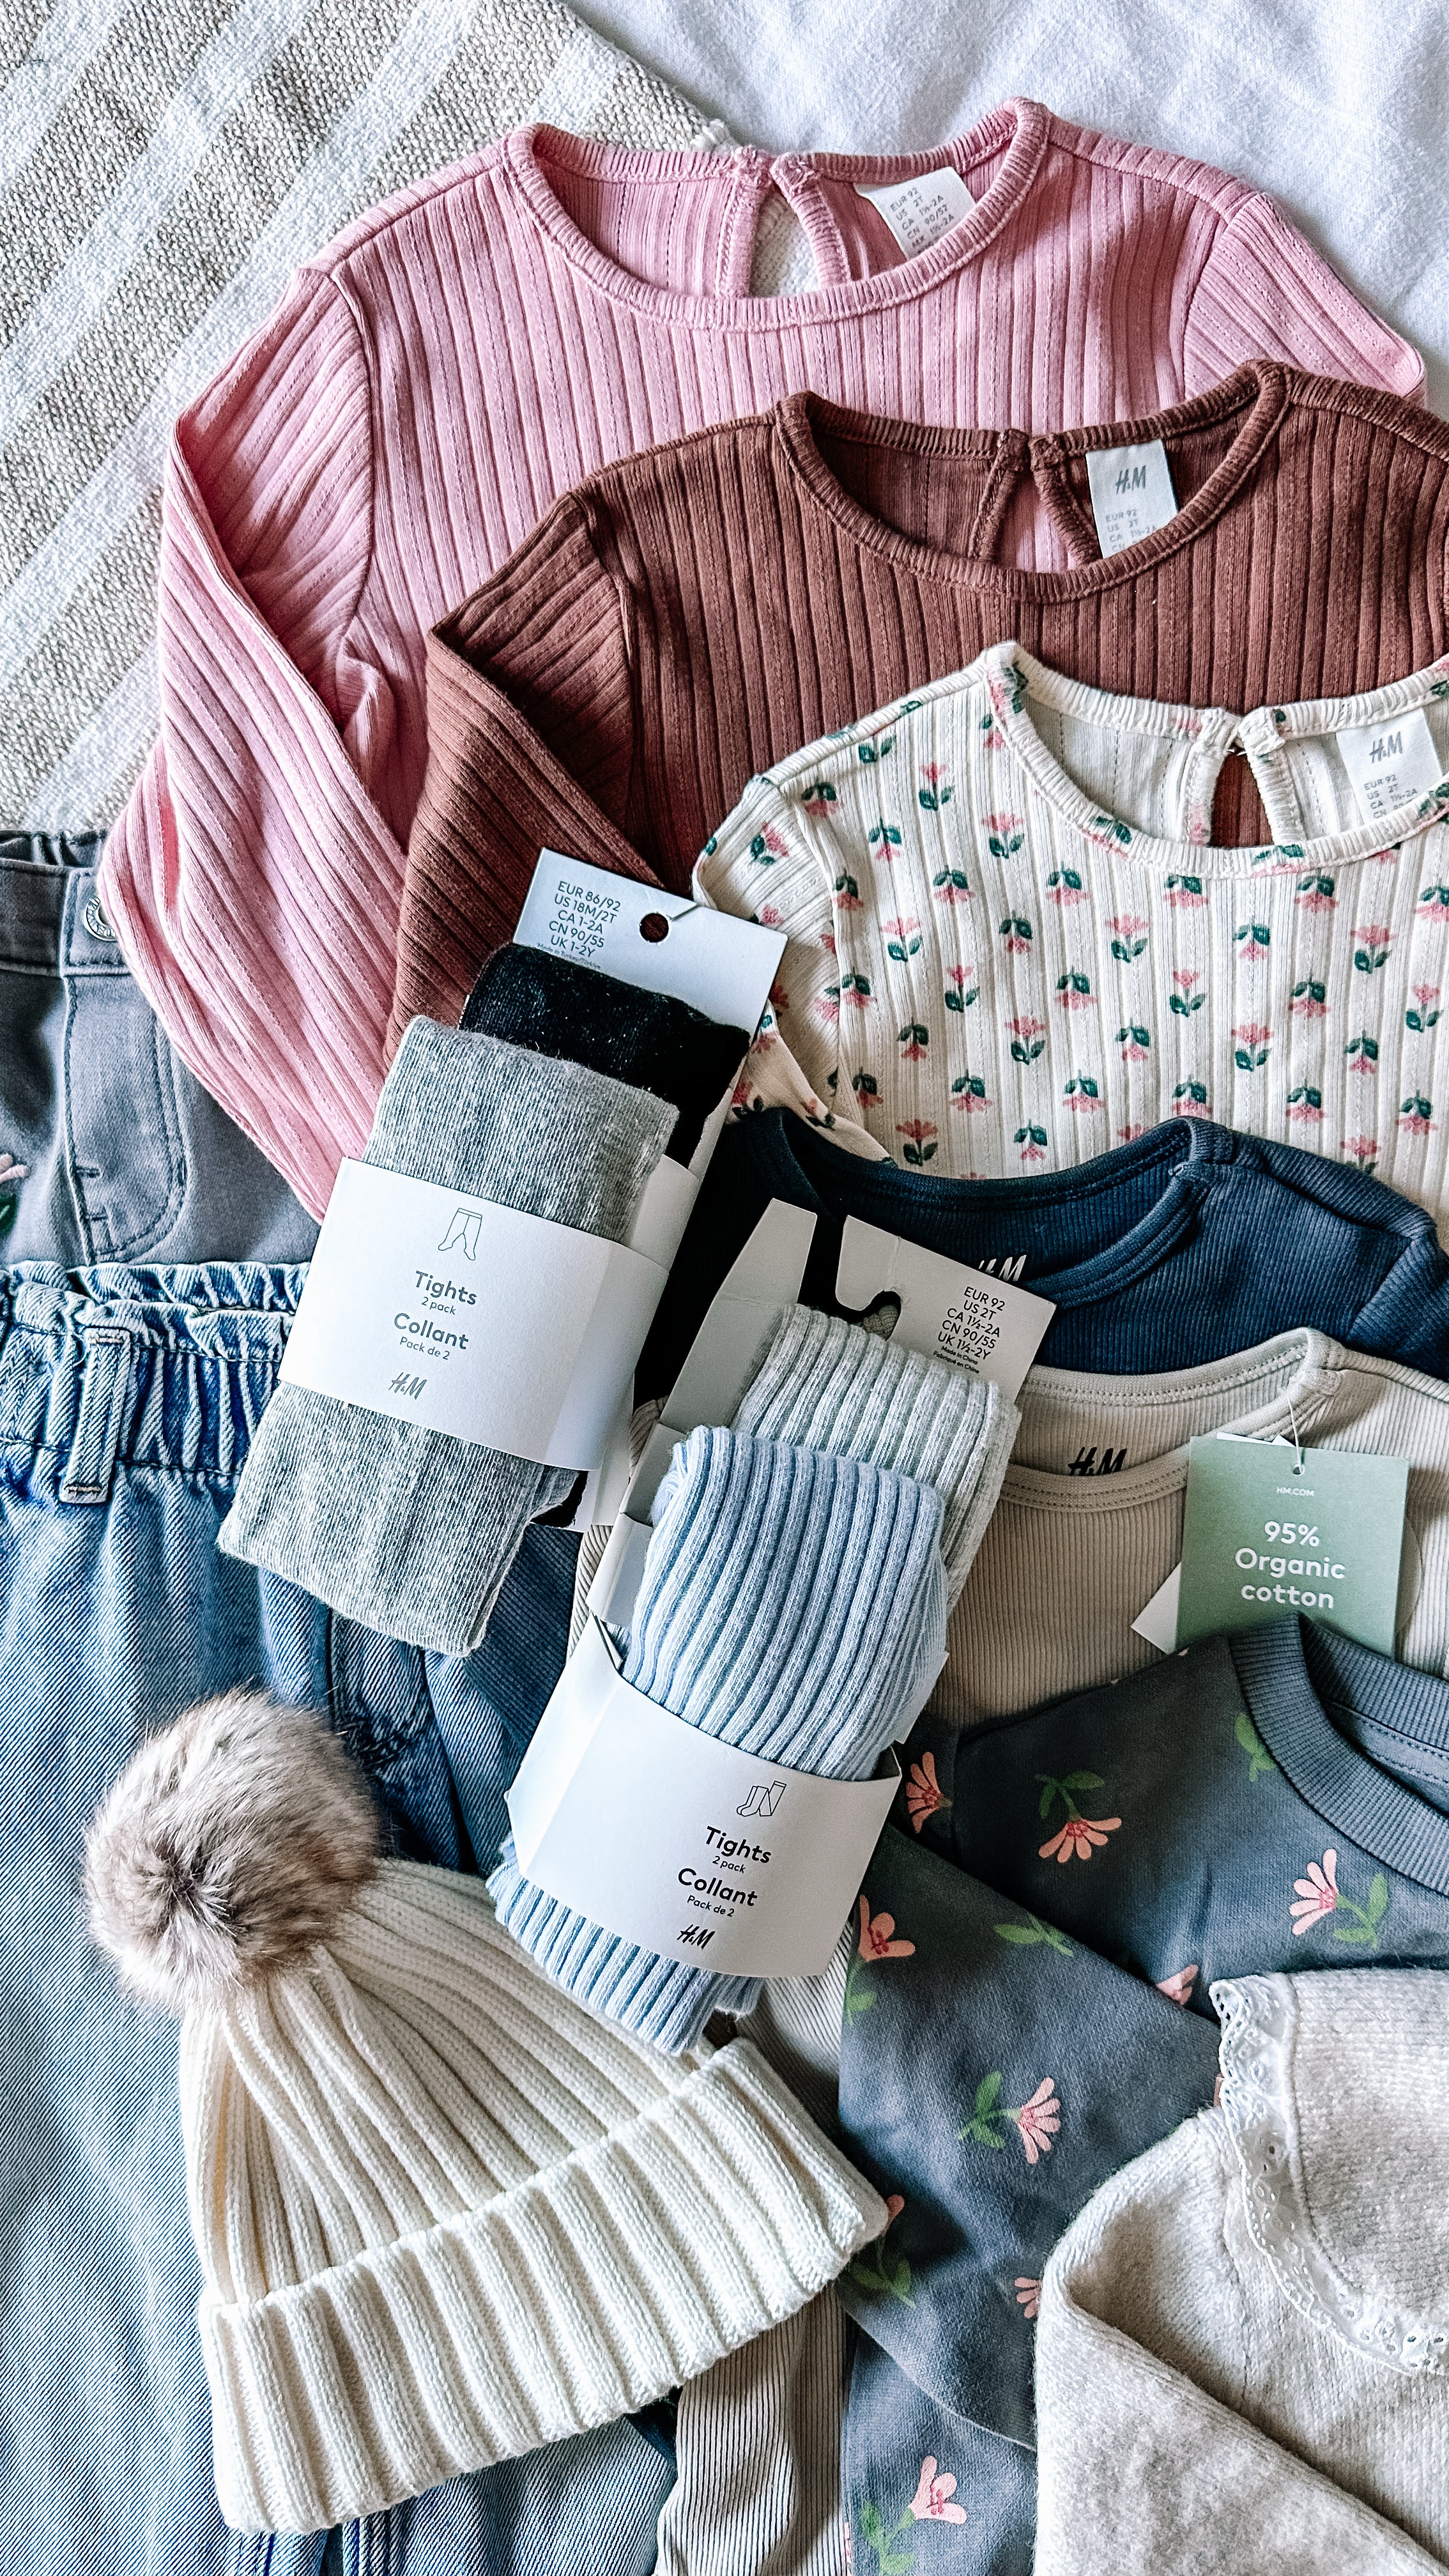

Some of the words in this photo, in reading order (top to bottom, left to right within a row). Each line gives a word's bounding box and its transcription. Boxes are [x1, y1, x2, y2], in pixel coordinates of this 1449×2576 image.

[890, 196, 907, 212] EUR
[908, 187, 918, 198] 92
[896, 209, 908, 220] US
[914, 196, 923, 208] 2T
[902, 218, 914, 230] CA
[907, 227, 920, 239] CN
[1115, 465, 1146, 495] H&M
[1106, 512, 1124, 523] EUR
[1108, 524, 1119, 532] US
[1110, 534, 1123, 542] CA
[1370, 732, 1402, 763] H&M
[1364, 779, 1383, 790] EUR
[1367, 791, 1379, 800] US
[1388, 784, 1398, 793] 2T
[1370, 801, 1383, 809] CA
[1374, 809, 1386, 818] CN
[555, 894, 571, 907] US
[574, 900, 617, 923] 18M/2T
[558, 881, 583, 898] EUR
[586, 891, 621, 912] 86/92
[549, 921, 568, 935] CN
[571, 928, 605, 947] 90/55
[558, 910, 575, 924] CA
[579, 917, 602, 934] 1-2A
[551, 935, 569, 949] UK
[571, 942, 595, 957] 1-2Y
[416, 1270, 477, 1305] Tights
[964, 1287, 989, 1305] EUR
[991, 1298, 1005, 1312] 92
[421, 1297, 429, 1307] 2
[430, 1300, 456, 1315] pack
[963, 1300, 980, 1314] US
[981, 1308, 997, 1321] 2T
[394, 1313, 469, 1350] Collant
[942, 1320, 961, 1334] CN
[963, 1328, 996, 1349] 90/55
[947, 1308, 963, 1322] CA
[967, 1315, 1000, 1338] 1½-2A
[400, 1336, 425, 1353] Pack
[427, 1346, 441, 1358] de
[443, 1351, 450, 1360] 2
[938, 1331, 956, 1346] UK
[957, 1339, 992, 1360] 1½-2Y
[941, 1346, 956, 1356] Made
[963, 1355, 978, 1365] China
[965, 1364, 979, 1374] Chine
[388, 1372, 427, 1400] H&M
[1068, 1446, 1128, 1476] H&M
[1276, 1487, 1314, 1497] HM.COM
[1264, 1521, 1321, 1547] 95%
[1235, 1547, 1347, 1579] Organic
[1241, 1584, 1335, 1609] cotton
[706, 1826, 772, 1864] Tights
[712, 1856, 721, 1865] 2
[720, 1860, 746, 1873] pack
[678, 1868, 758, 1906] Collant
[687, 1895, 712, 1910] Pack
[713, 1905, 726, 1915] de
[727, 1908, 735, 1917] 2
[677, 1924, 716, 1949] H&M
